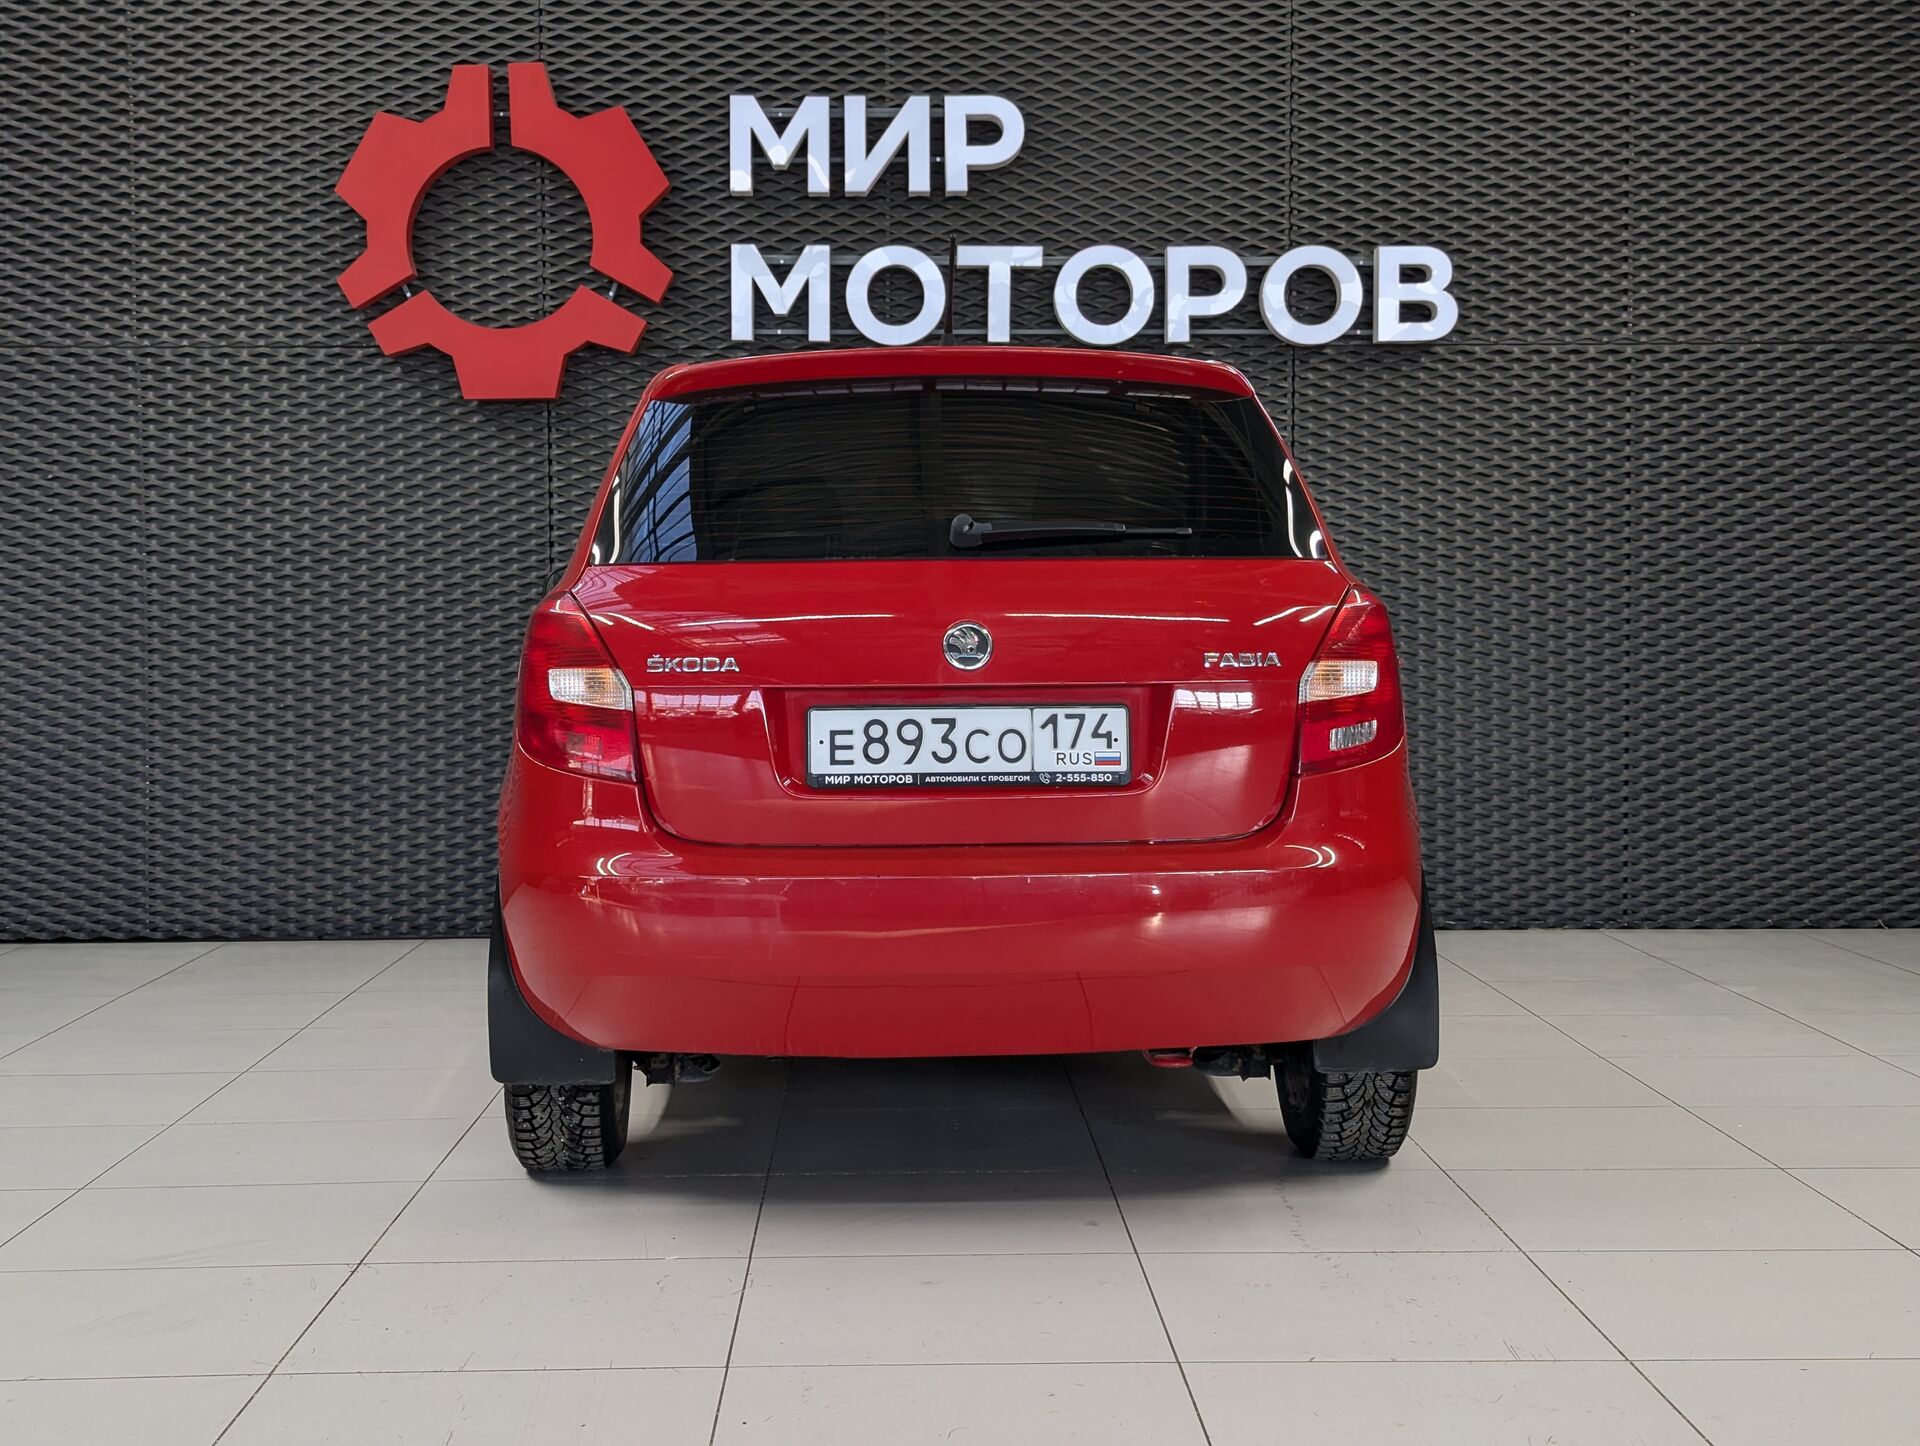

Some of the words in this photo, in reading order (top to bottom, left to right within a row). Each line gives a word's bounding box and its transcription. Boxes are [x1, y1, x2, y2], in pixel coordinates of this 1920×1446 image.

[729, 95, 1026, 197] МИР
[730, 243, 1459, 346] МОТОРОВ
[646, 654, 740, 673] ŠKODA
[1203, 652, 1282, 668] FABIA
[1039, 713, 1113, 750] 174
[1056, 752, 1093, 766] RUS
[825, 775, 851, 785] МИР
[854, 774, 913, 784] МОТОРОВ
[1055, 773, 1112, 782] 2-555-850
